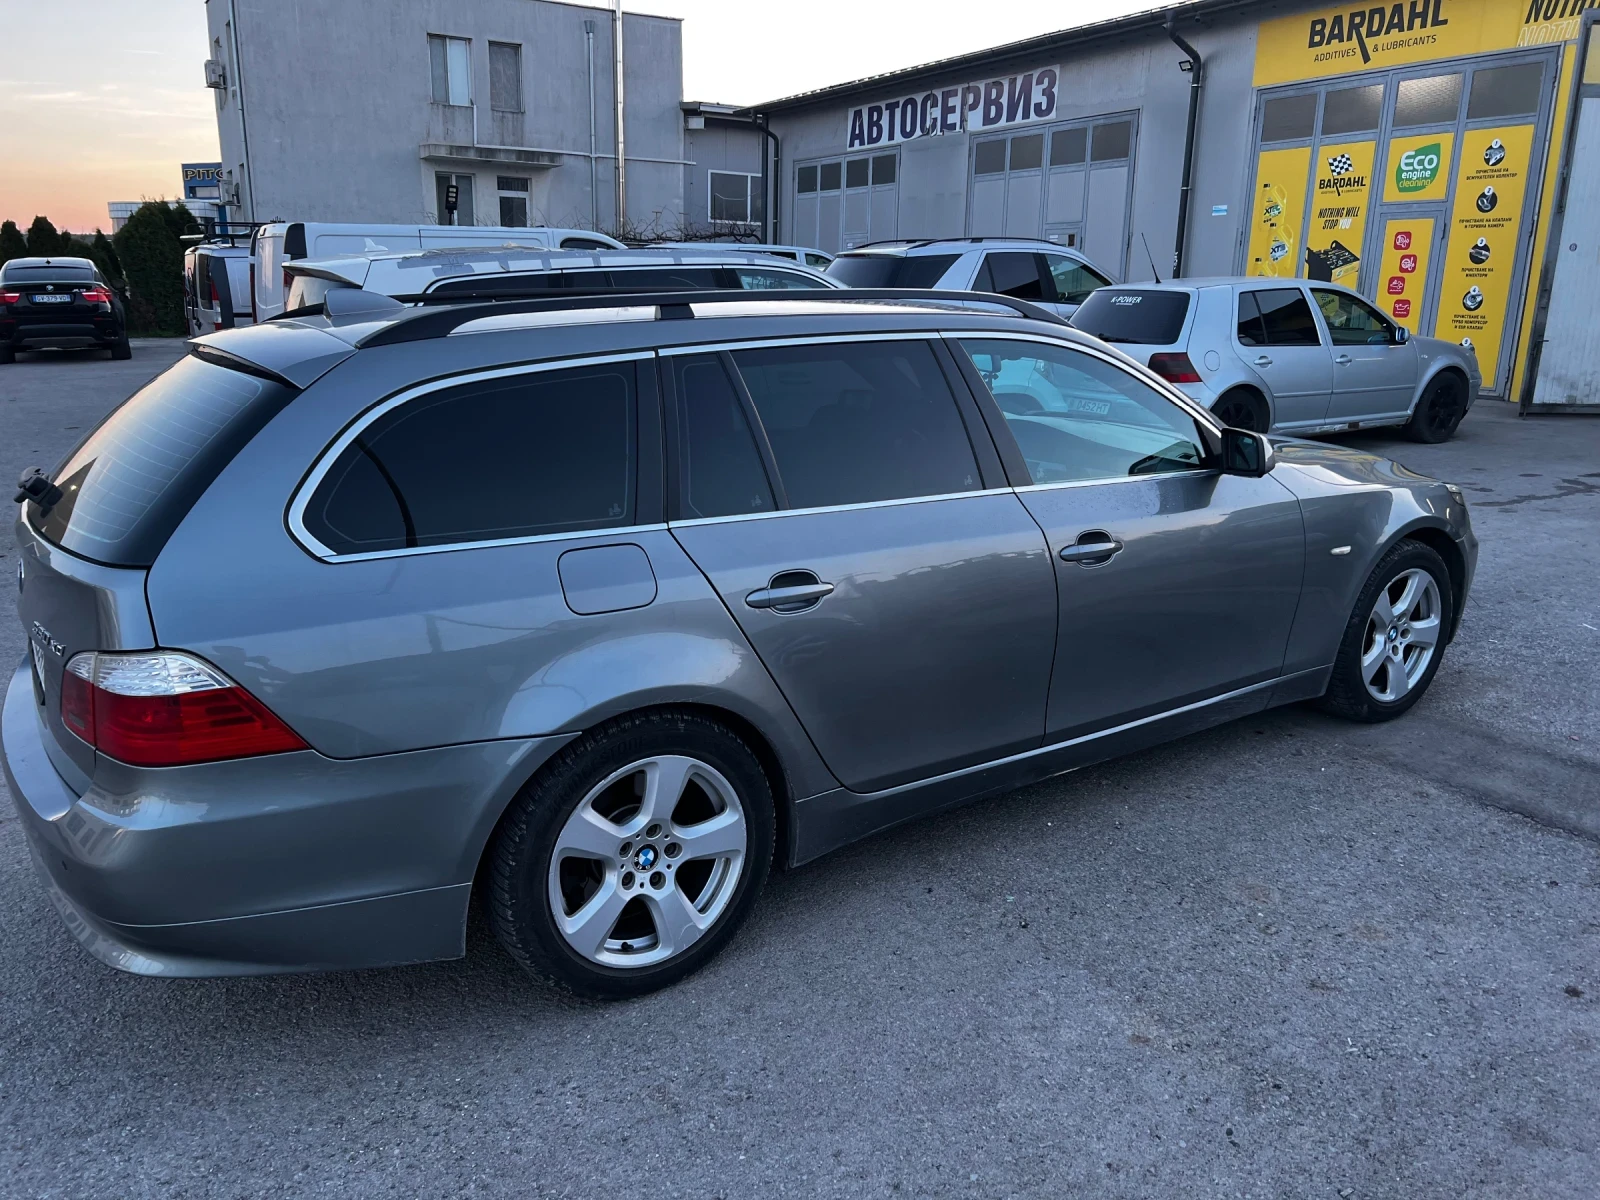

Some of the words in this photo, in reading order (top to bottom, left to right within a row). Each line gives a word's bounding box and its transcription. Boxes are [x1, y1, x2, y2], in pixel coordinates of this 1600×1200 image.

[1308, 0, 1449, 64] BARDAHL
[1314, 48, 1357, 62] ADDITIVES
[1372, 44, 1379, 53] &
[1382, 34, 1437, 51] LUBRICANTS
[848, 69, 1058, 148] АВТОСЕРВИЗ
[1400, 151, 1438, 170] Eco
[1399, 178, 1432, 188] cleaning
[1401, 169, 1431, 180] engine
[1319, 176, 1366, 196] BARDAHL
[1317, 207, 1345, 218] NOTHING
[1345, 206, 1360, 217] WILL
[1322, 219, 1338, 230] STOP
